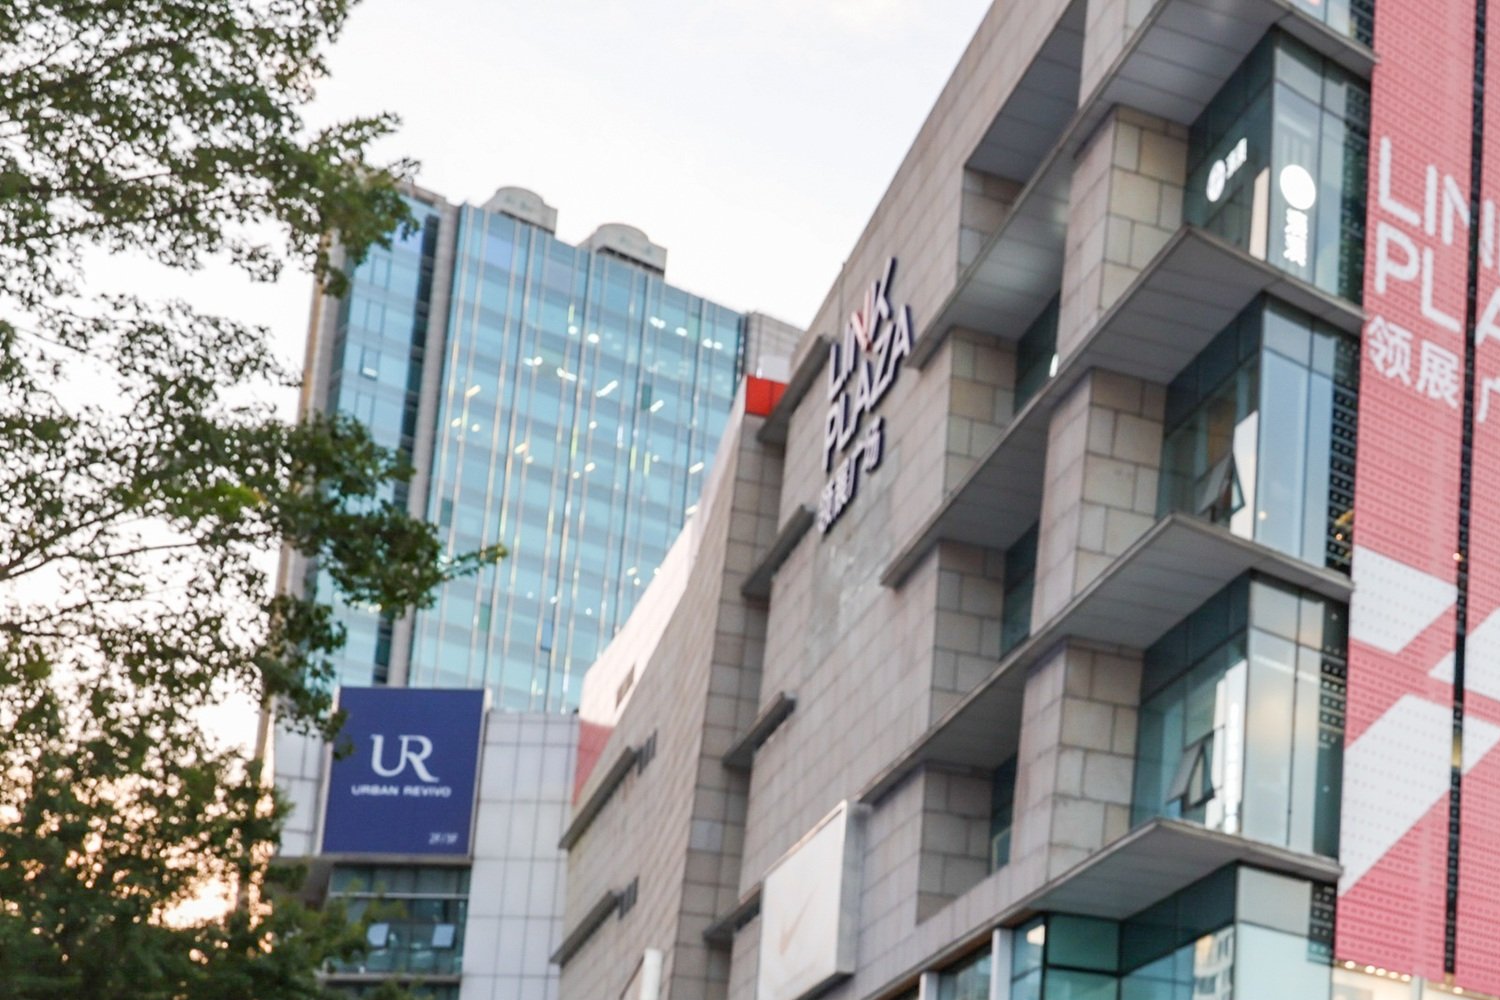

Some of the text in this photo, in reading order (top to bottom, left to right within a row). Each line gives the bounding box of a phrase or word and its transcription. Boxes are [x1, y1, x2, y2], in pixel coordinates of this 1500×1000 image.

[823, 303, 914, 474] PLAZA
[827, 256, 898, 401] LINK
[369, 733, 440, 783] UR
